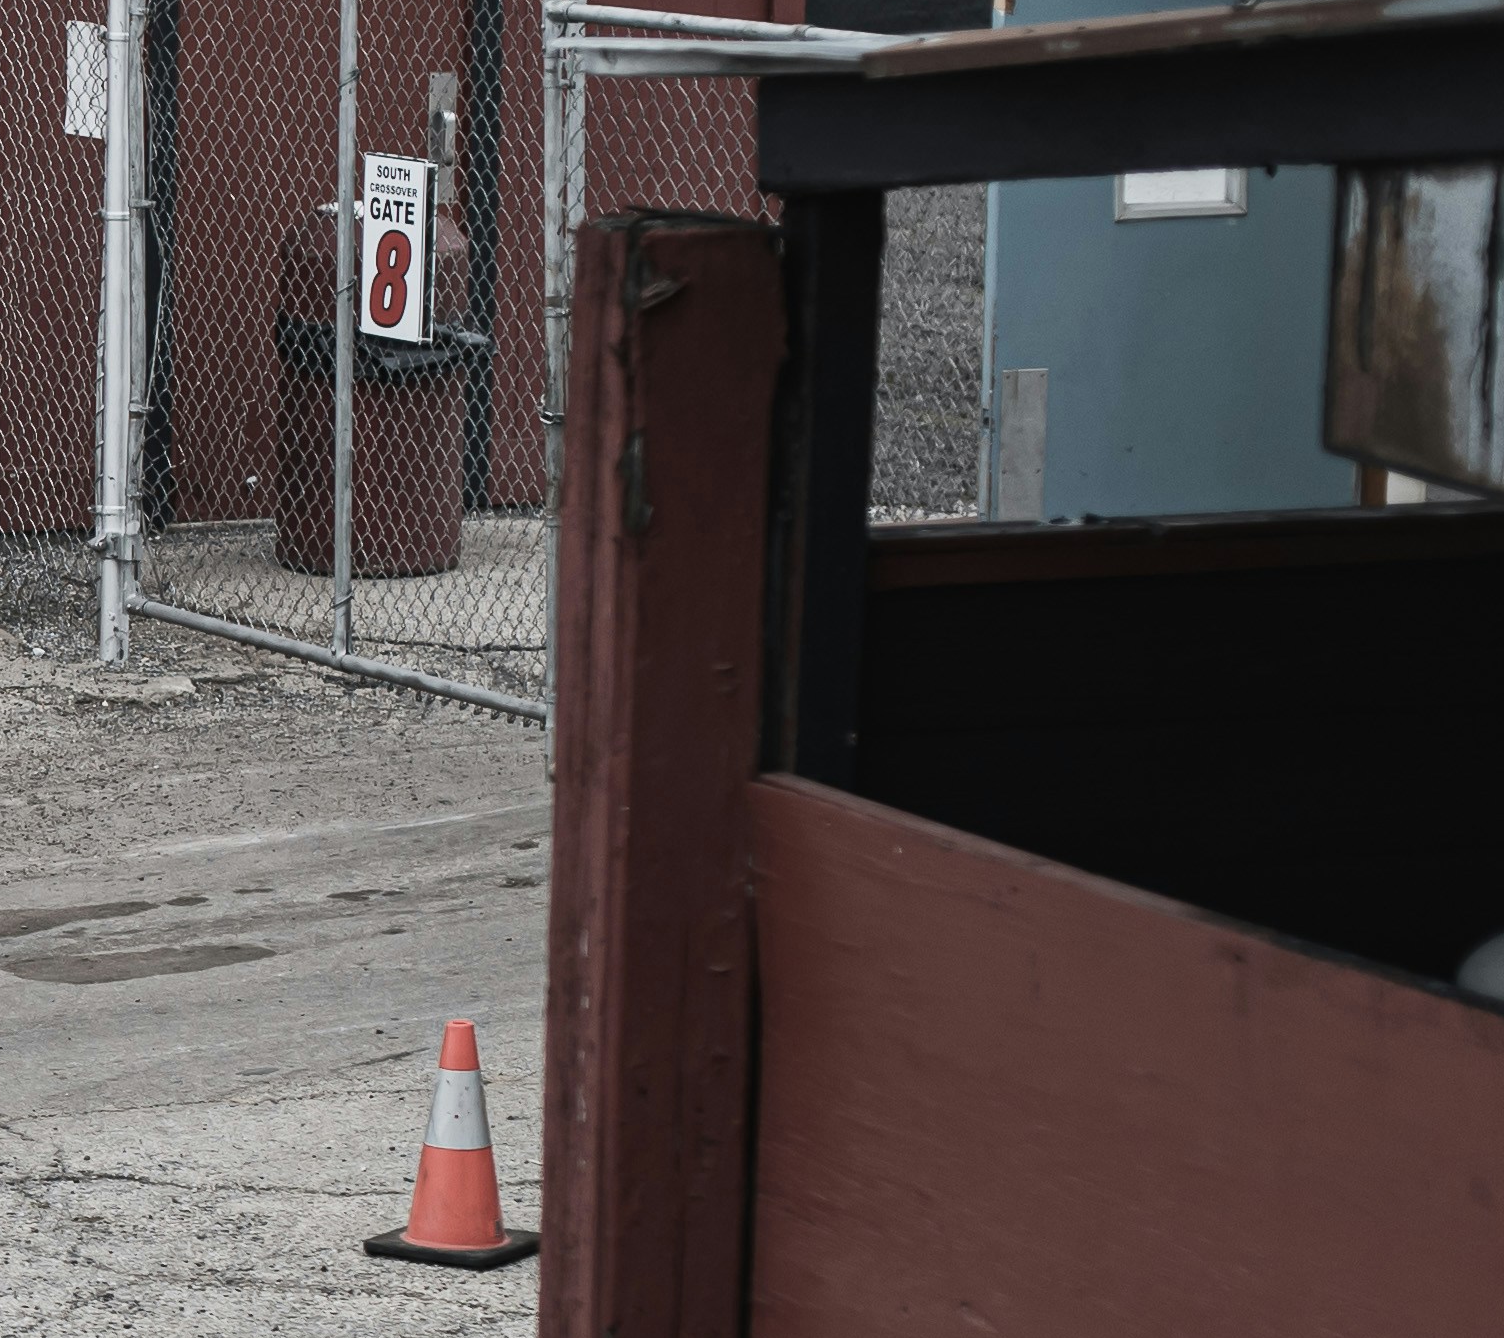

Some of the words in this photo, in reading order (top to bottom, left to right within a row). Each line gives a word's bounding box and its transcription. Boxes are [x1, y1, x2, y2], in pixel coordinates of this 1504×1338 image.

[376, 165, 411, 182] SOUTH
[369, 182, 418, 198] CROSSOVER
[369, 196, 415, 225] GATE
[369, 229, 412, 329] 8
